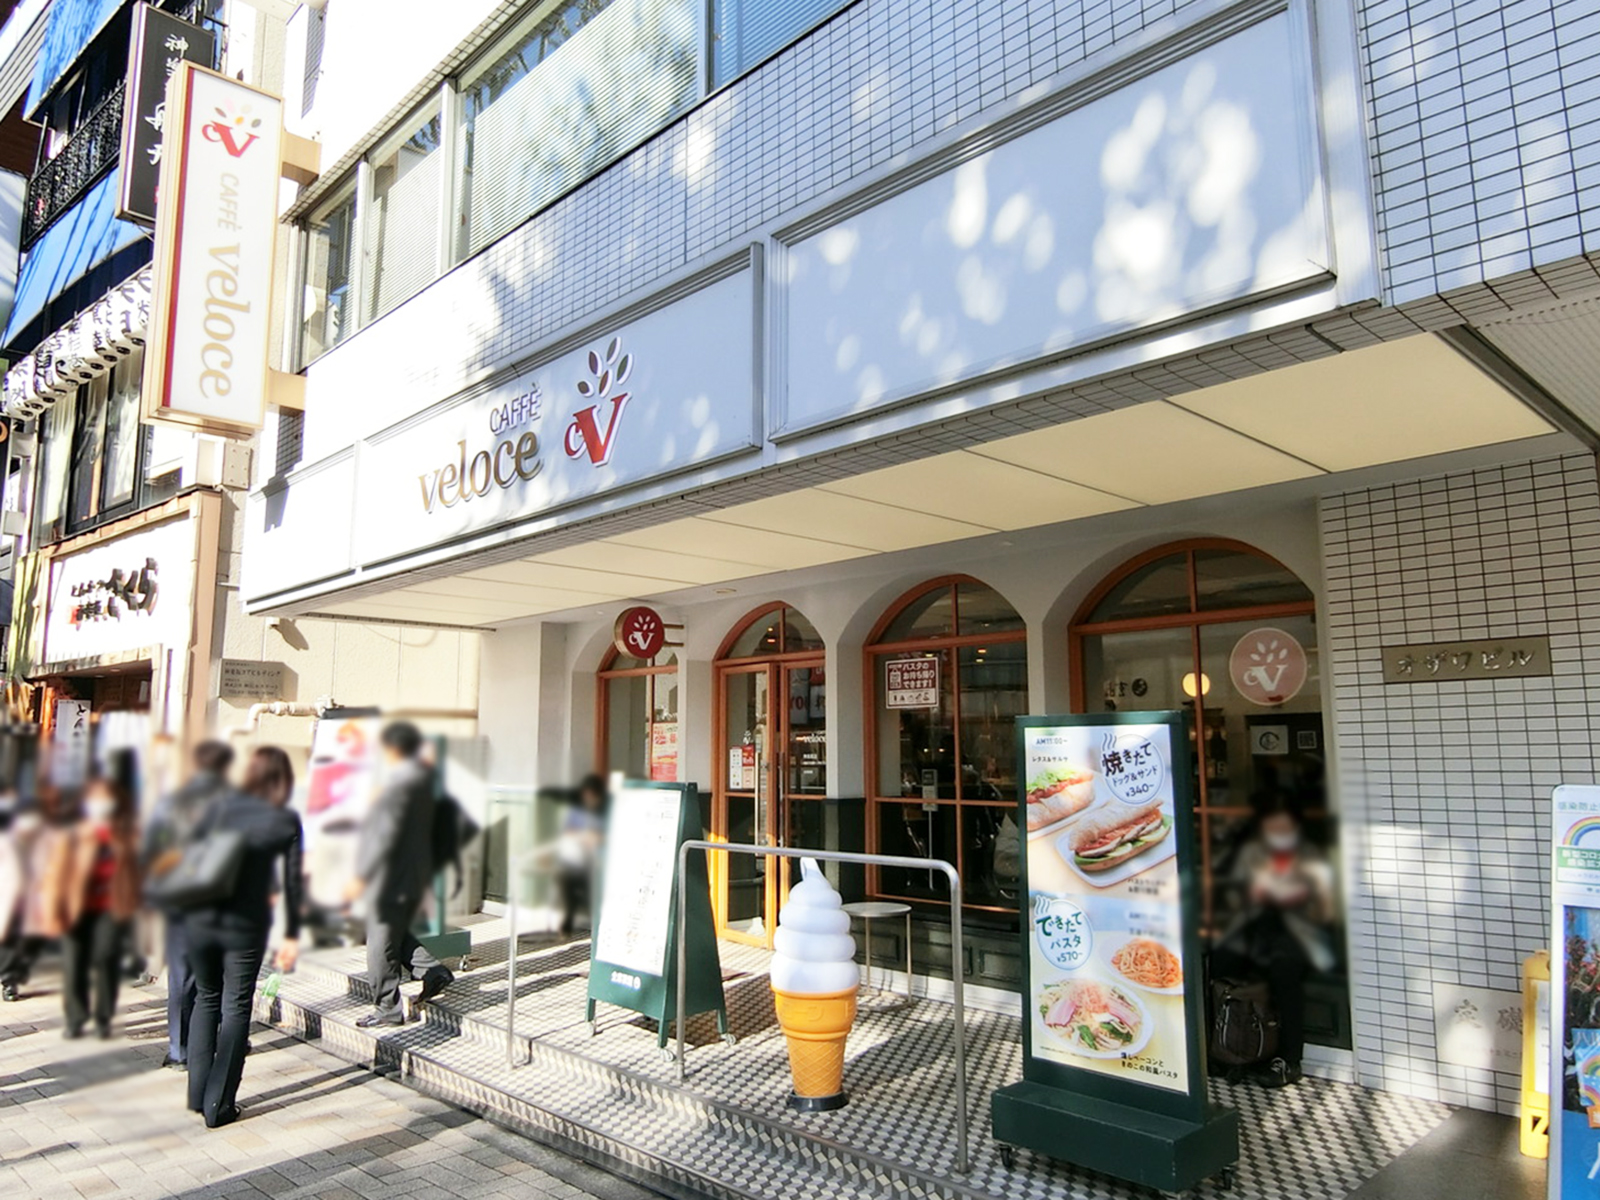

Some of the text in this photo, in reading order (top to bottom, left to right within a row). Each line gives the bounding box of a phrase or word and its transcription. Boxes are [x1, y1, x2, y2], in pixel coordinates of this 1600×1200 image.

[199, 243, 251, 399] veloce
[418, 430, 545, 514] veloce
[902, 662, 929, 671] パスタの
[903, 669, 935, 680] お持ち帰り
[1396, 648, 1536, 676] オザワビル
[1102, 742, 1152, 777] 焼きたて
[1112, 764, 1159, 788] ドッグ&サンド
[1558, 801, 1600, 812] 感染防止
[1035, 911, 1083, 937] できたて
[1050, 935, 1083, 950] パスタ
